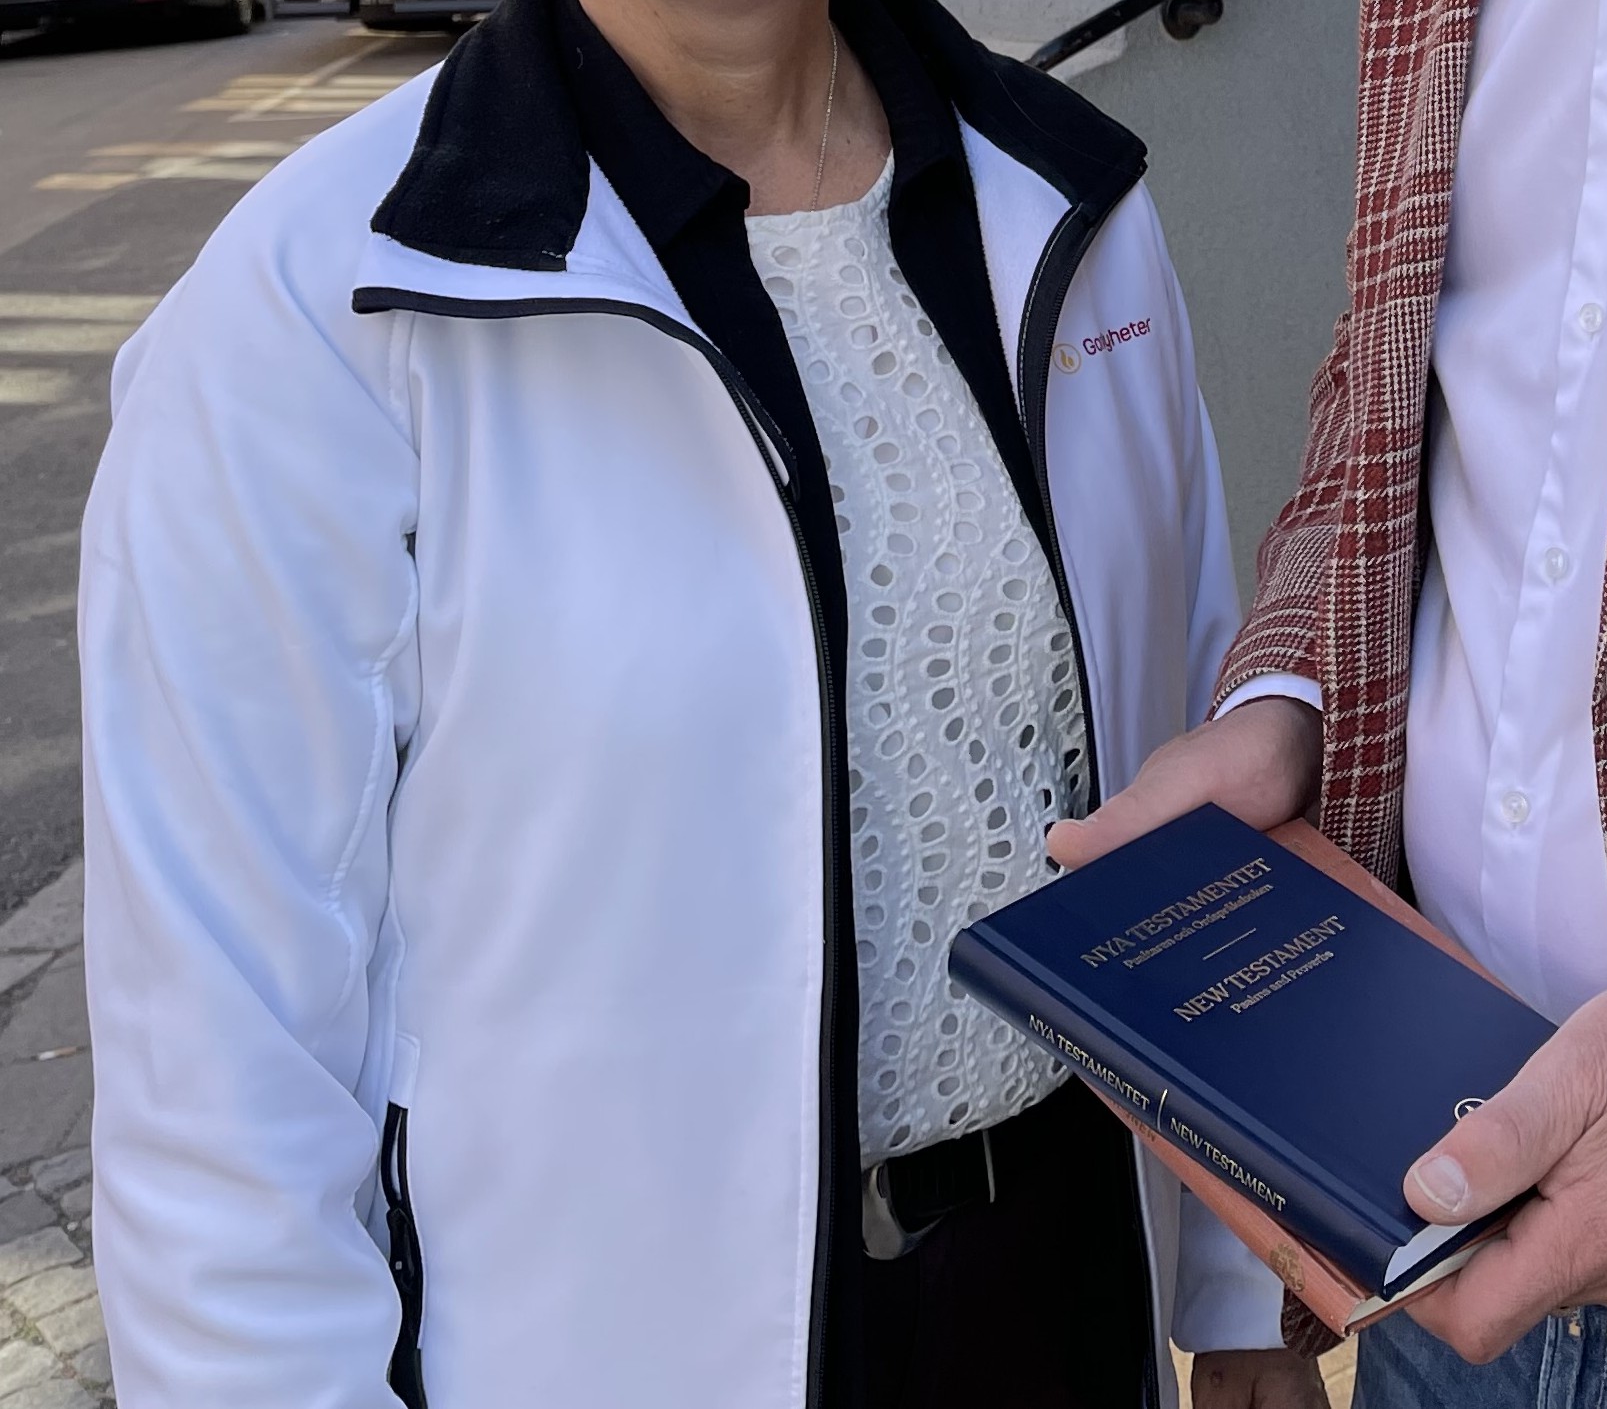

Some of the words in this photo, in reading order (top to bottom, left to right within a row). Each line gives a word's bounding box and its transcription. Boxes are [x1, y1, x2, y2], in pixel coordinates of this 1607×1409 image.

[1080, 935, 1136, 969] NYA
[1126, 857, 1273, 941] TESTAMENTET
[1173, 981, 1231, 1023] NEW
[1223, 915, 1346, 991] TESTAMENT
[1230, 986, 1272, 1015] Psalms
[1268, 973, 1291, 992] and
[1289, 950, 1335, 981] Proverbs
[1029, 1014, 1055, 1045] NYA
[1056, 1034, 1150, 1111] TESTAMENTET
[1170, 1117, 1205, 1150] NEW
[1203, 1141, 1286, 1213] TESTAMENT
